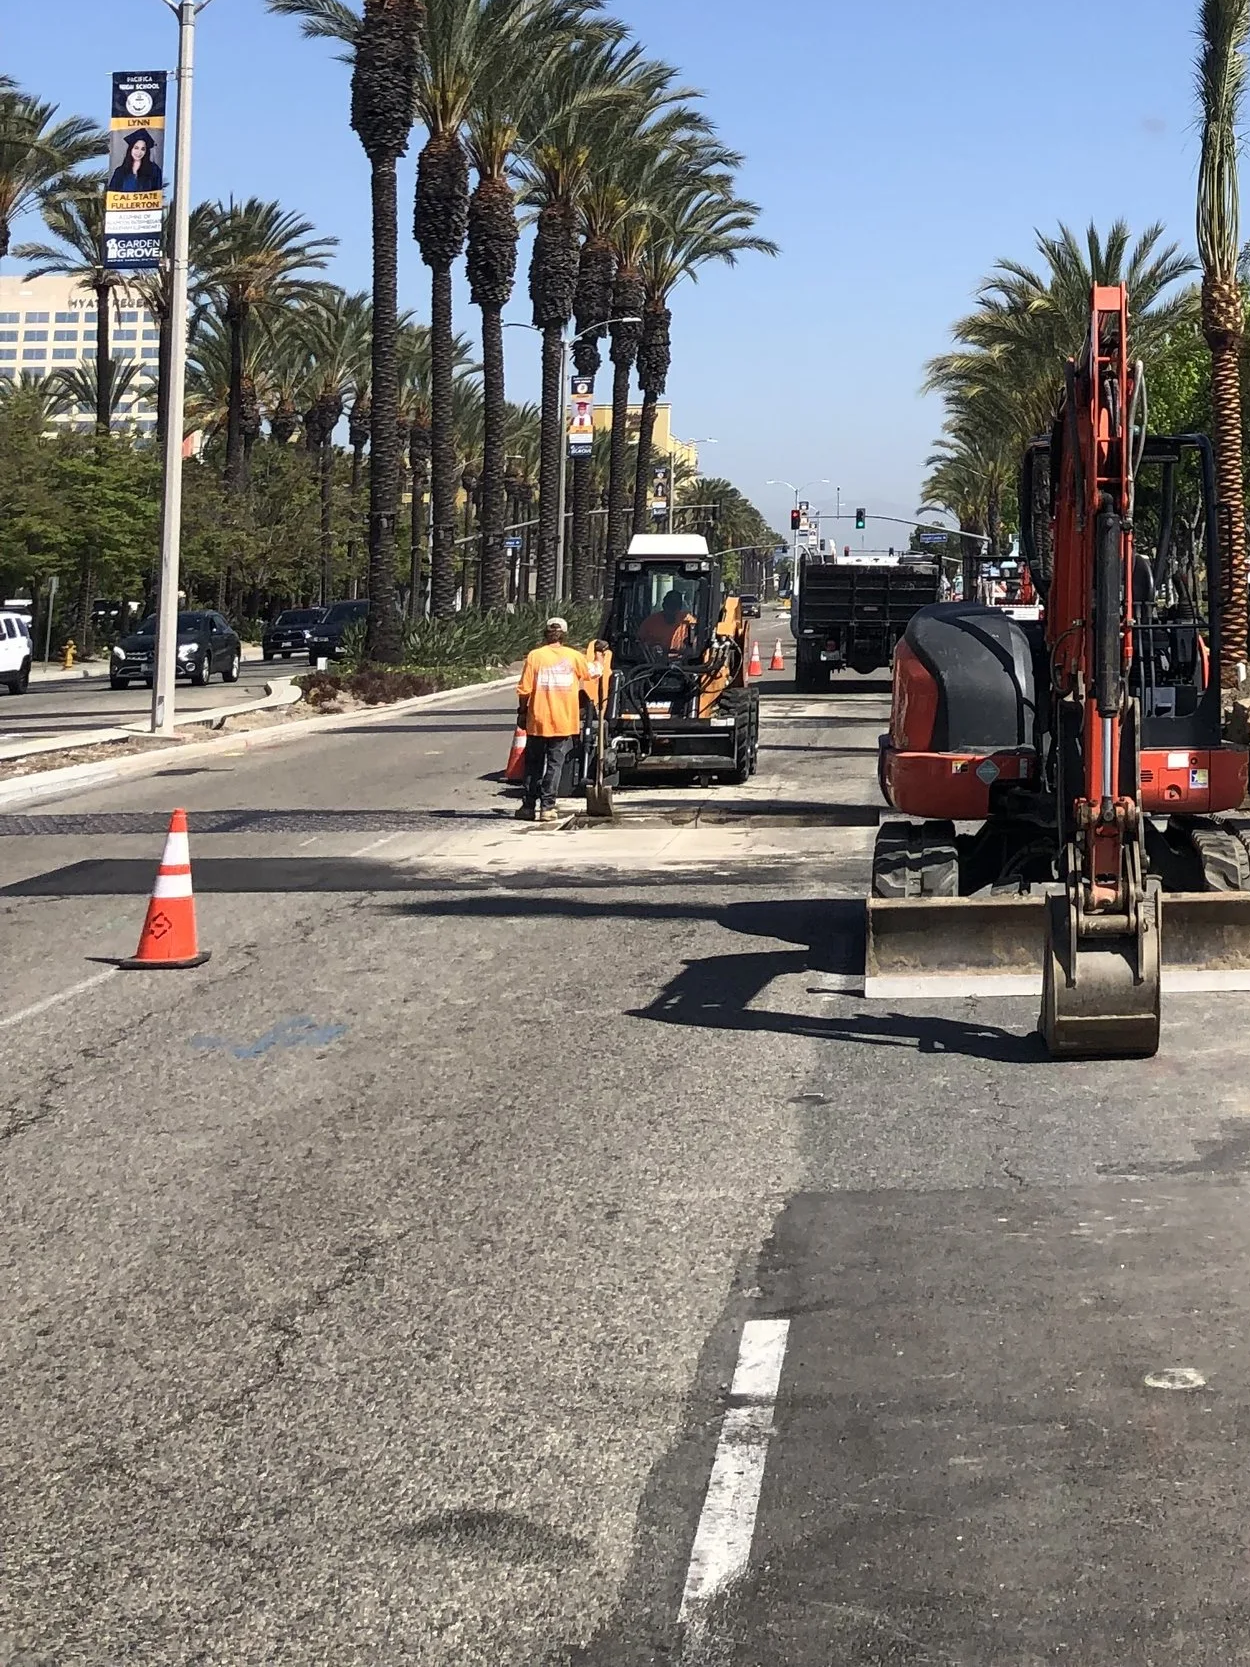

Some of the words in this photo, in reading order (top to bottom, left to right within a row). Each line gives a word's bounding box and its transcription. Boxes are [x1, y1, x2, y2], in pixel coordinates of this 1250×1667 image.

[132, 192, 158, 200] STATE
[111, 201, 160, 209] FULLERTON
[117, 239, 160, 249] GARDEN
[117, 247, 160, 258] GROVE
